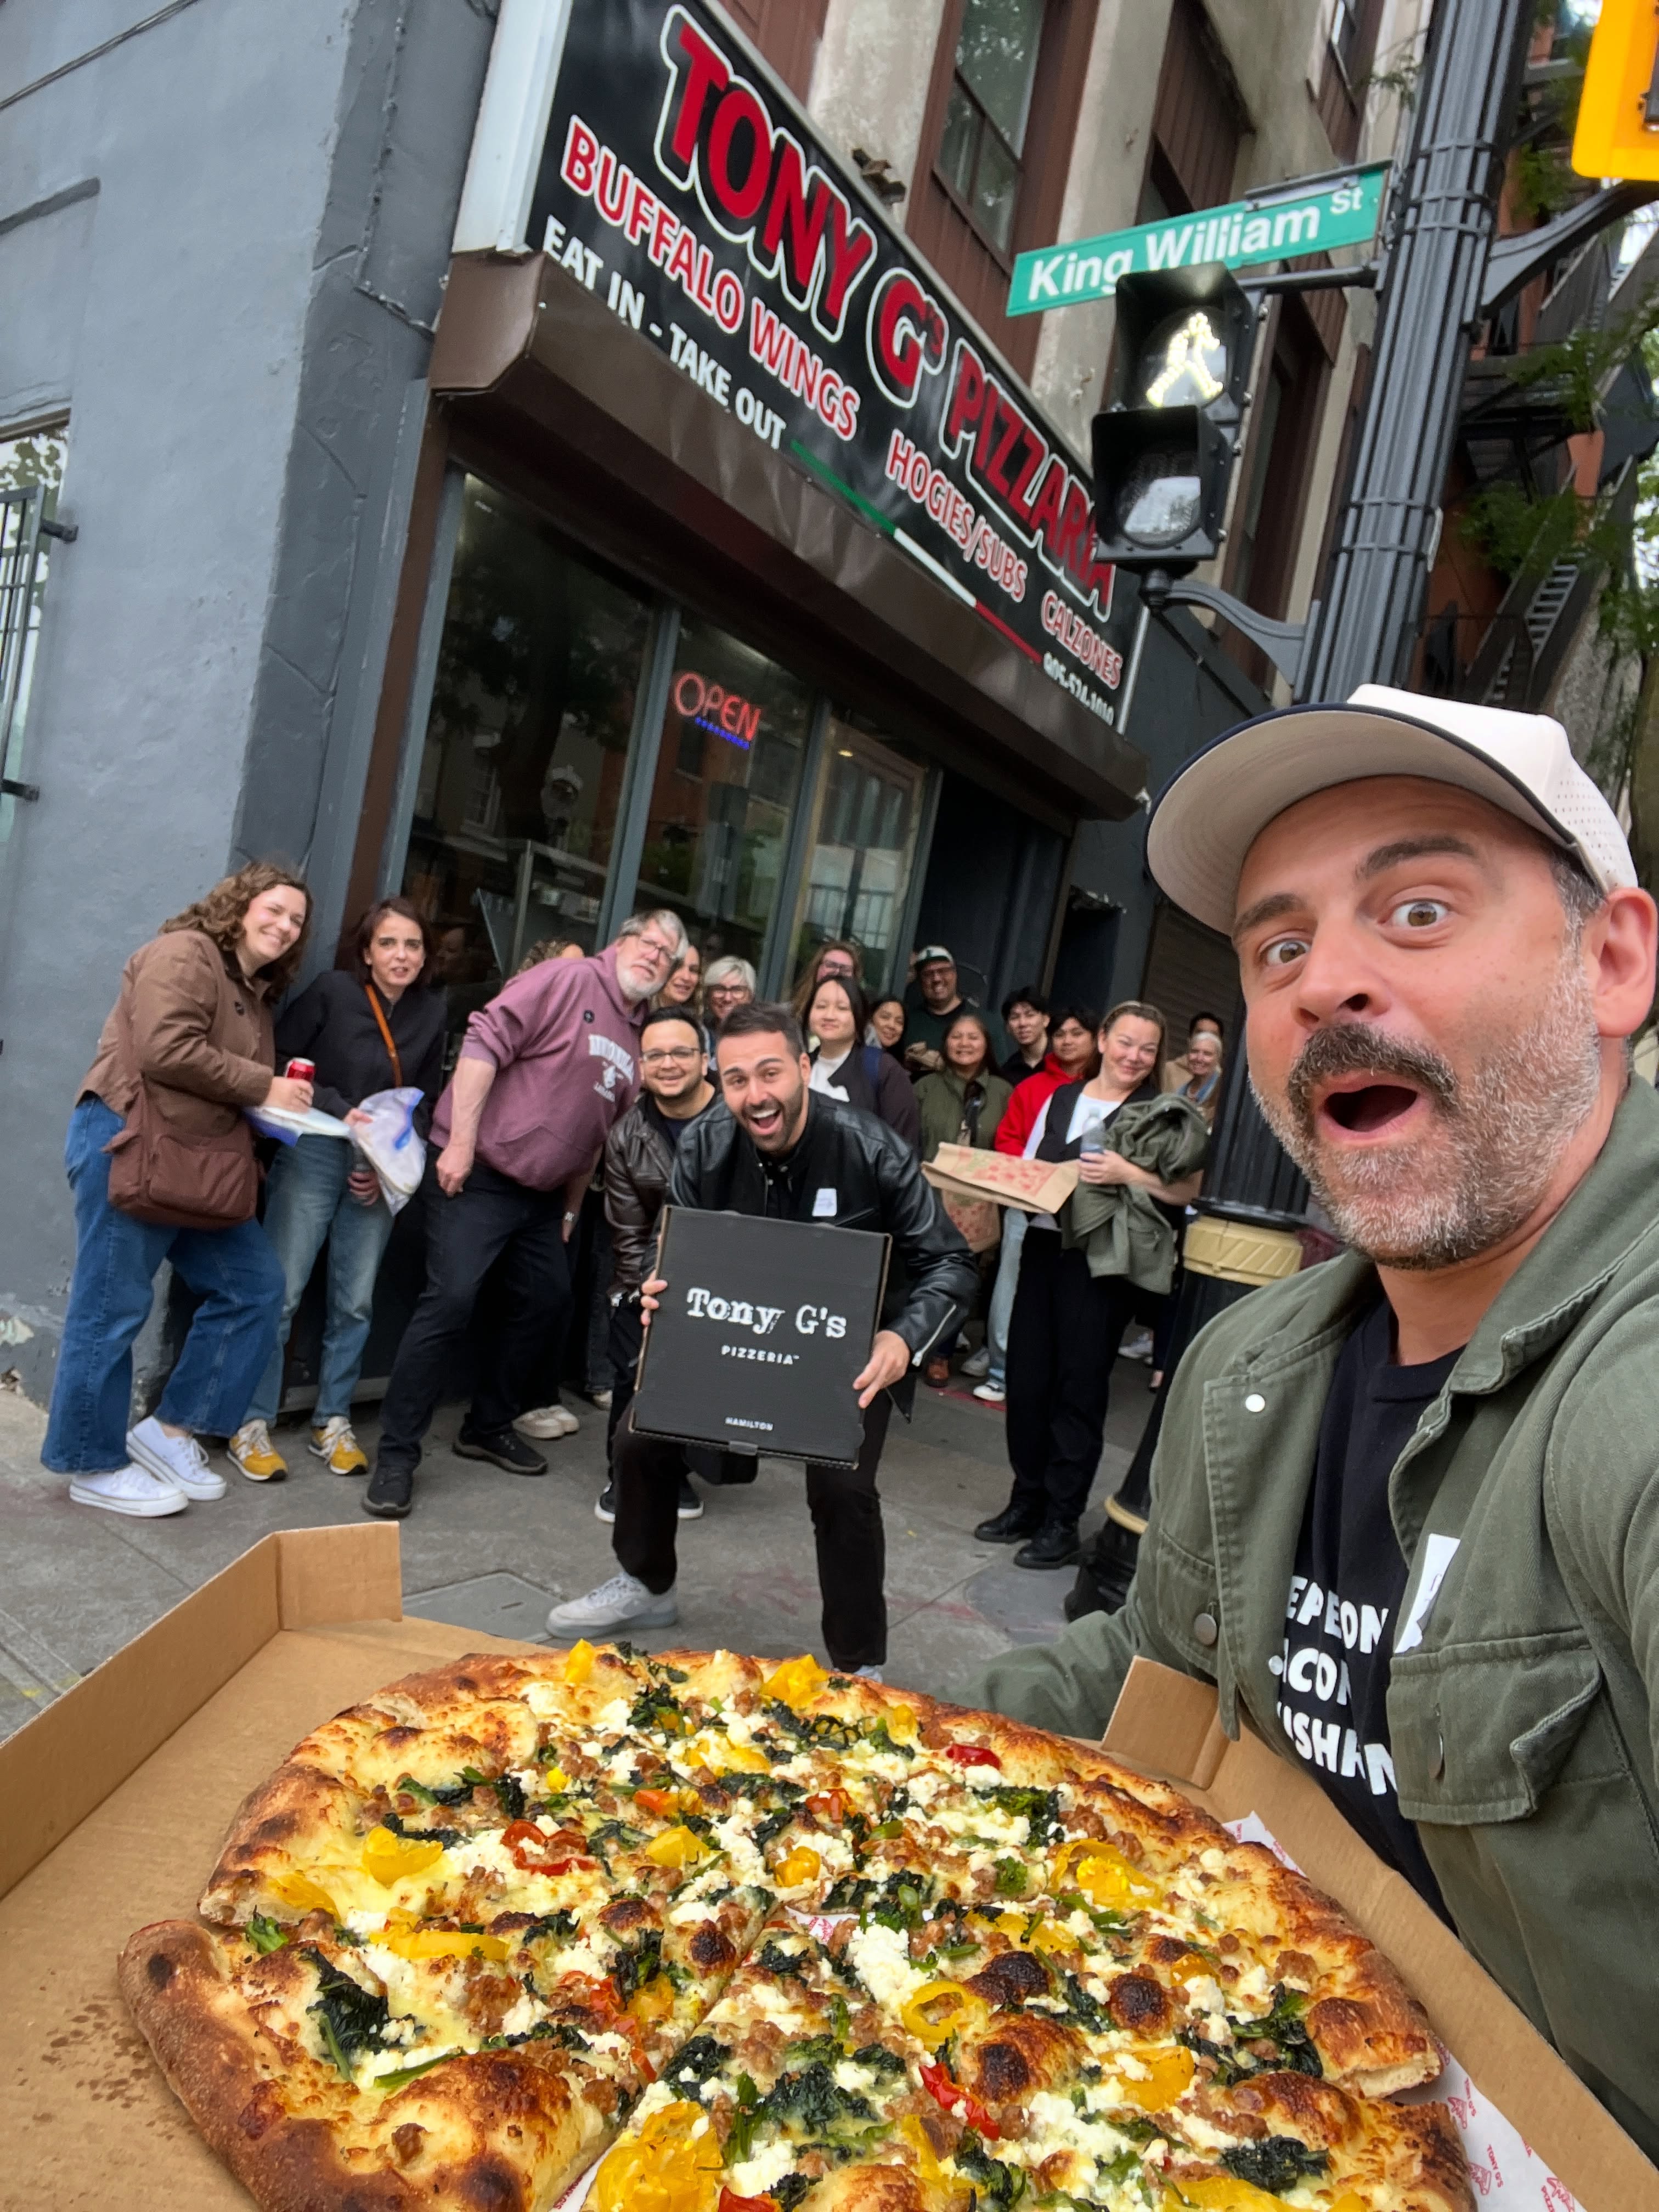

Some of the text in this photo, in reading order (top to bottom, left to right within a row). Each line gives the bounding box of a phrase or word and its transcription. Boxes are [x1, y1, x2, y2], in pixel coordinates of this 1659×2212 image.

[655, 5, 877, 341] TONY
[561, 115, 860, 441] BUFFALO WINGS
[1028, 186, 1363, 295] King William St
[543, 215, 603, 290] EAT
[607, 272, 645, 329] IN
[669, 323, 731, 406] TAKE
[735, 388, 786, 449] OUT
[885, 430, 1028, 603] HOGIES/SUBS
[1041, 590, 1123, 690] CALZONES
[674, 672, 761, 742] OPEN
[687, 1288, 847, 1338] Tony G's
[725, 1417, 774, 1431] HAMILTON
[1487, 2143, 1498, 2170] TONY
